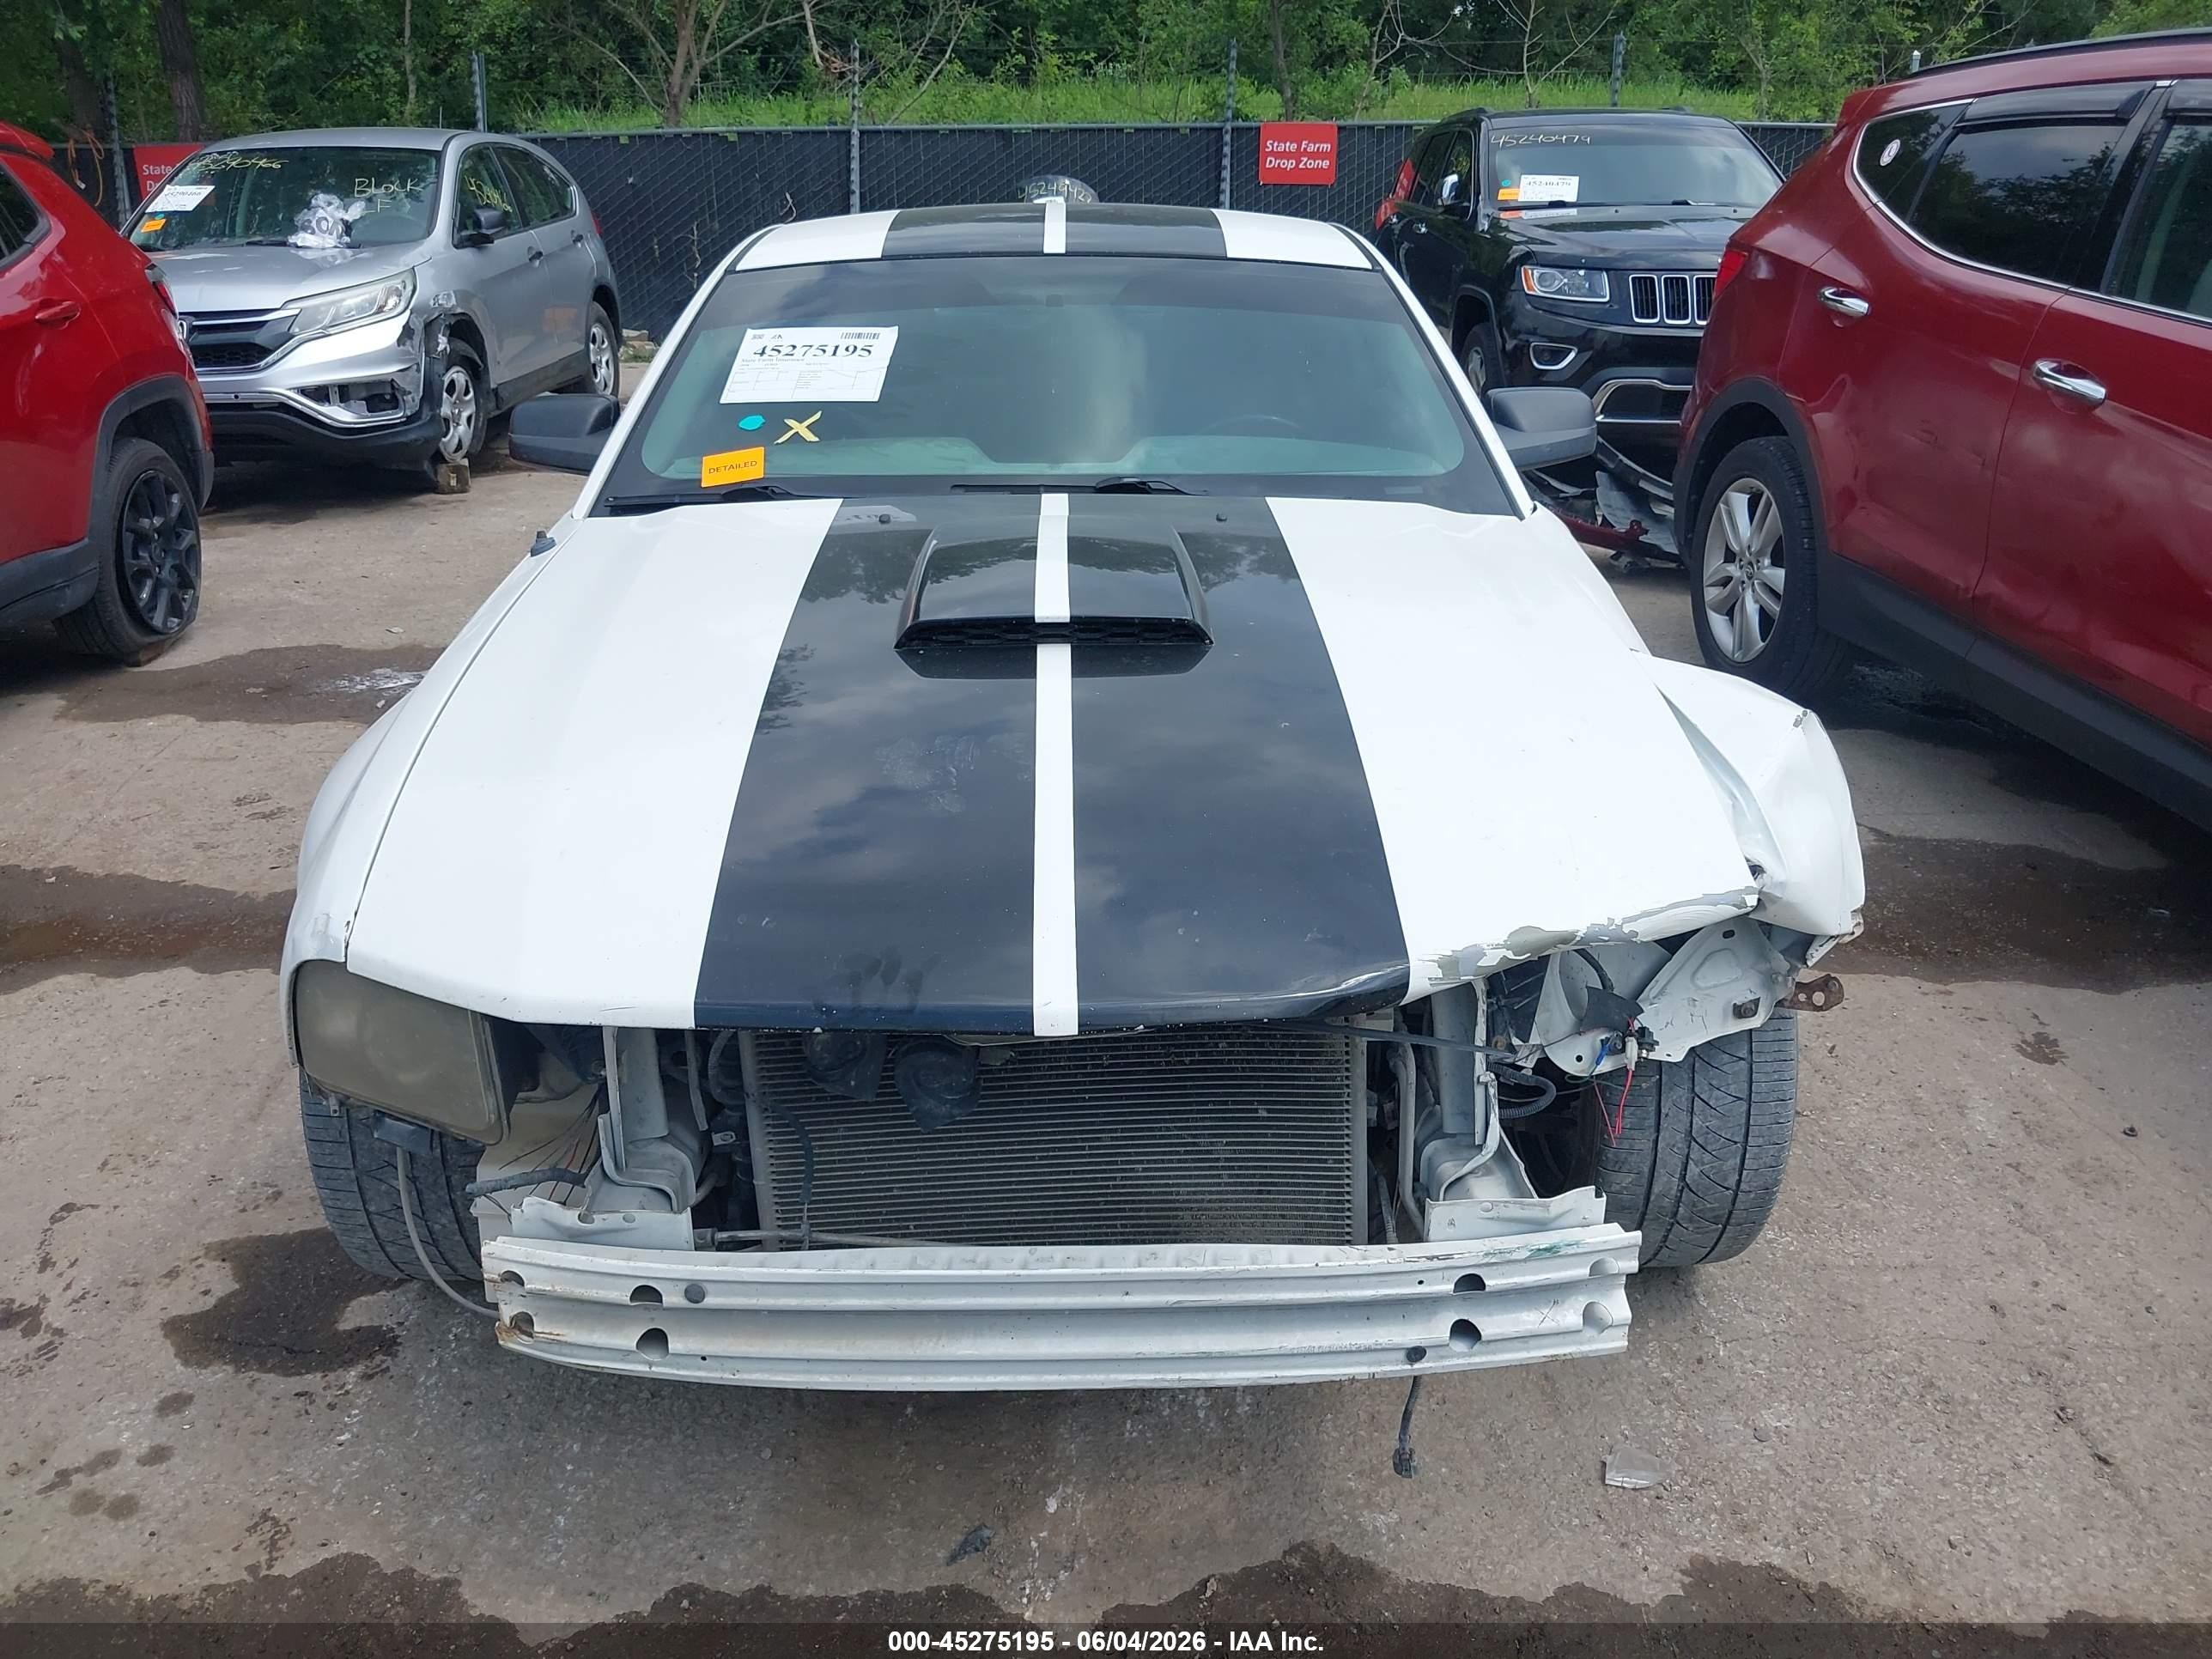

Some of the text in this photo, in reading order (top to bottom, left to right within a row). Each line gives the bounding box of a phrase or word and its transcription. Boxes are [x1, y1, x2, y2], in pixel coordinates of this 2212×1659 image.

[1265, 140, 1331, 152] State Farm
[1491, 135, 1590, 149] 45240479
[143, 164, 172, 175] State
[1266, 156, 1330, 171] Drop Zone
[354, 177, 423, 198] BLOCK
[753, 343, 874, 357] 45275195
[708, 460, 757, 474] DETAILED
